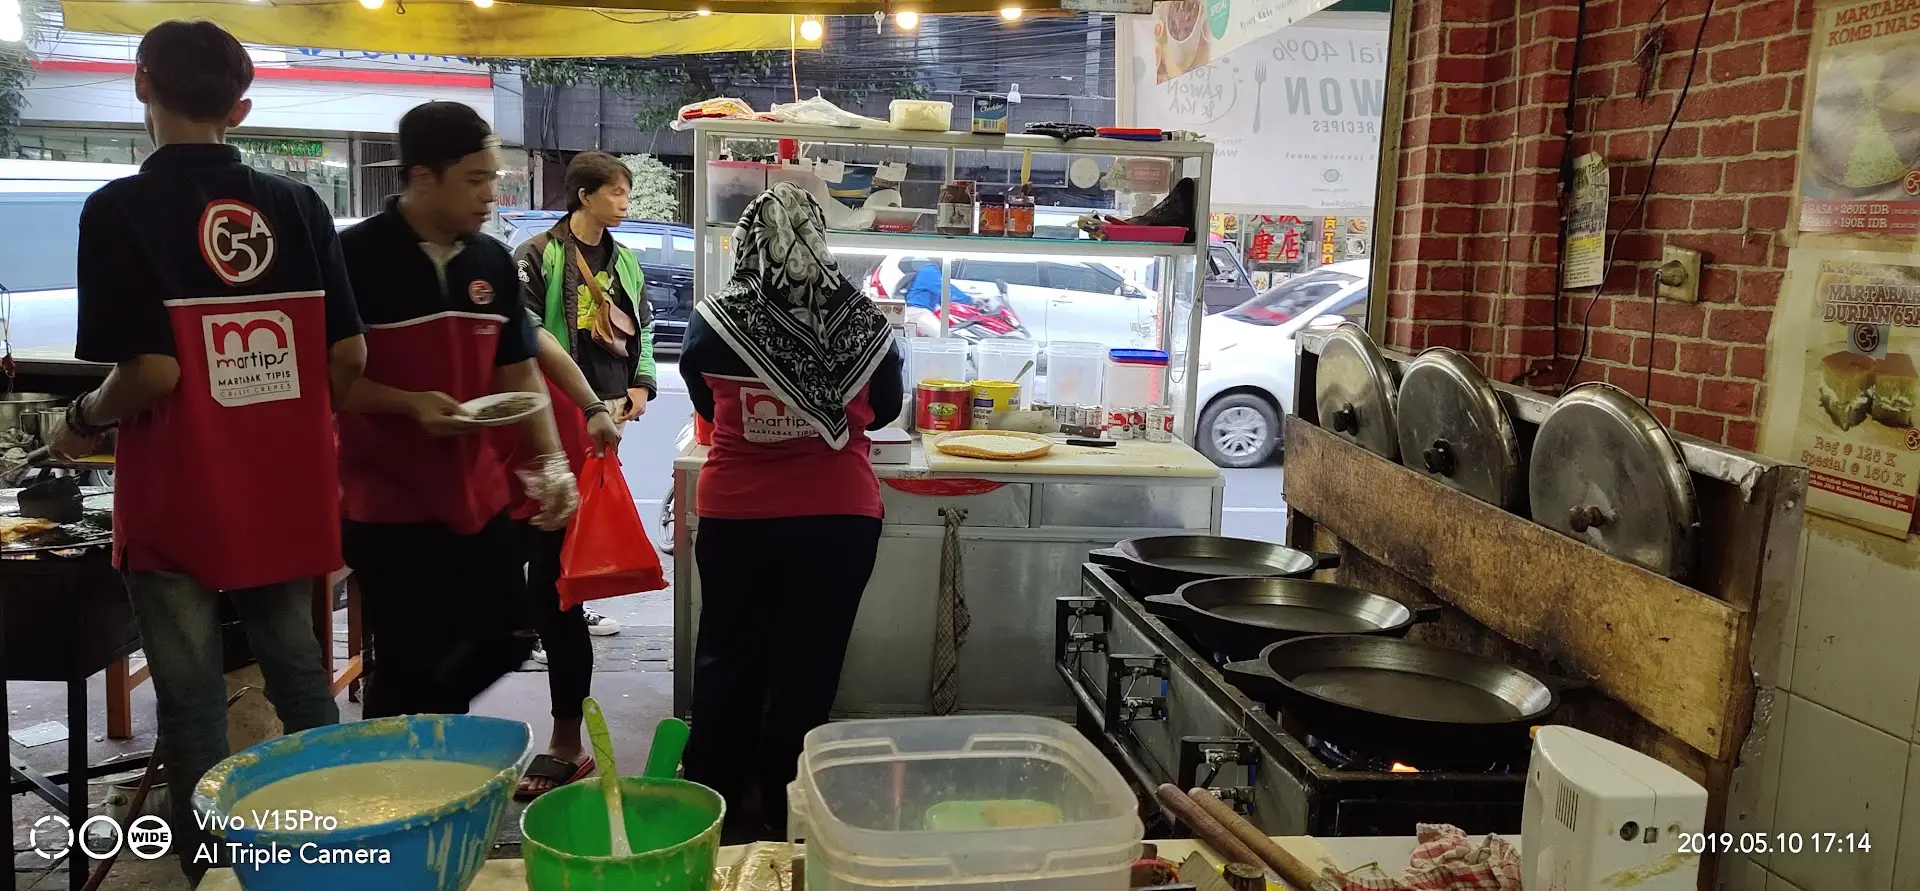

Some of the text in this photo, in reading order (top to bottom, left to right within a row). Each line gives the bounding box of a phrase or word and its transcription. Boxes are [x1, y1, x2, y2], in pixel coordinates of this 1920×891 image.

[1835, 0, 1920, 27] MARTABA
[1869, 205, 1889, 214] IDR
[1840, 218, 1866, 228] 190K
[1867, 218, 1888, 228] IDR
[1823, 303, 1892, 325] DURIAN
[216, 352, 288, 369] martips
[218, 370, 291, 386] MARTABAK TIPIS
[1814, 435, 1840, 456] Reg
[1884, 451, 1898, 468] K
[1892, 471, 1907, 487] K
